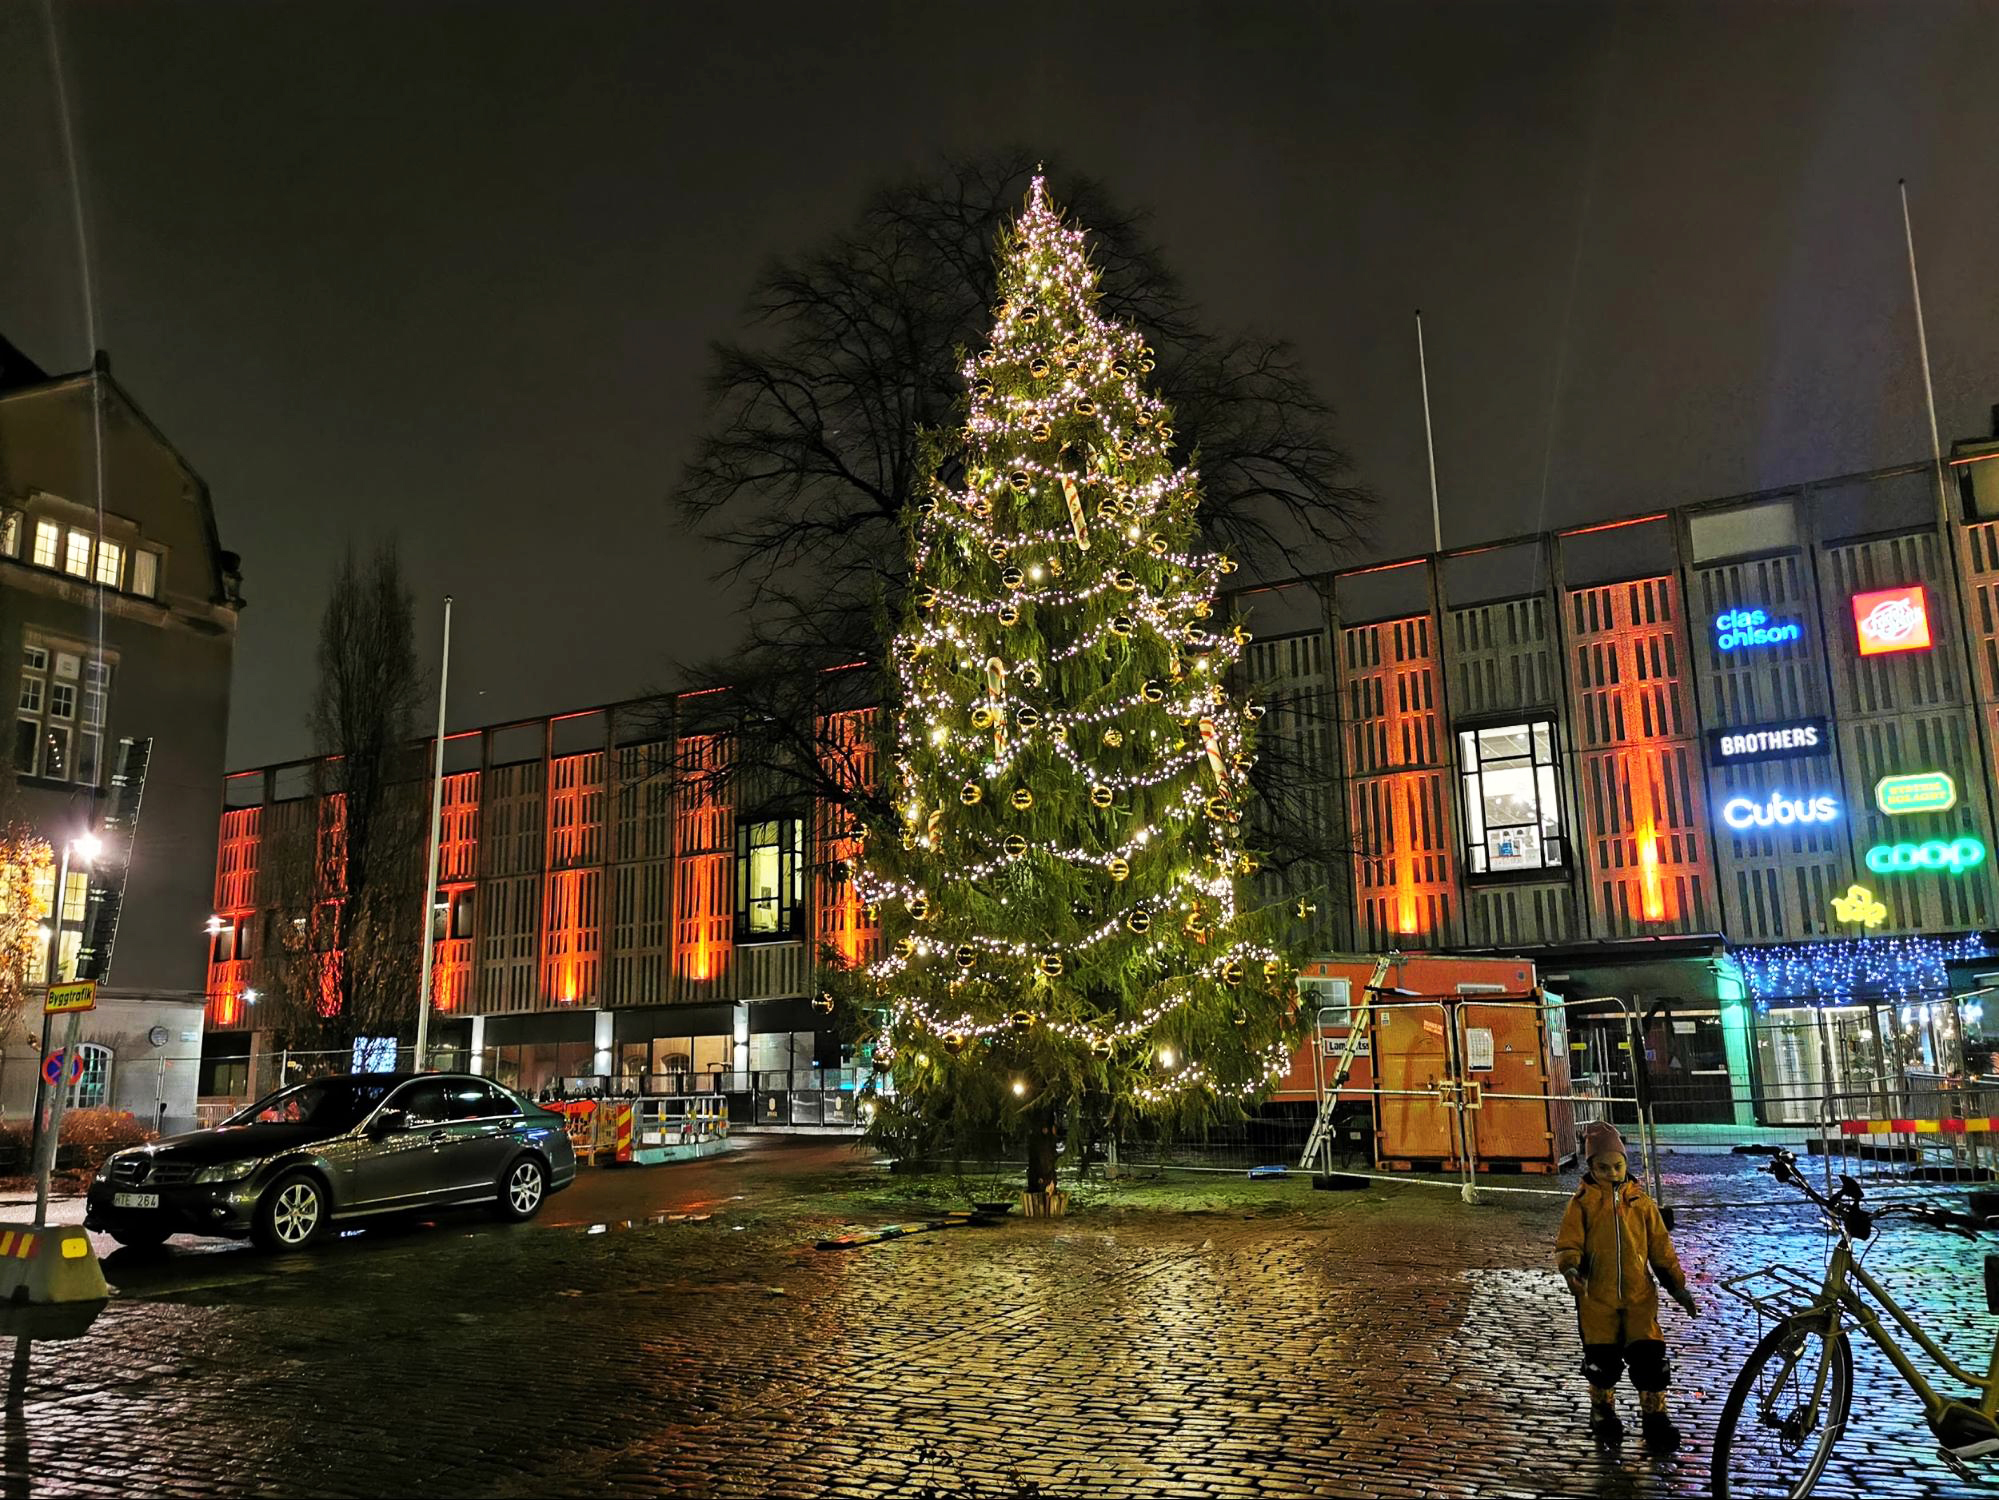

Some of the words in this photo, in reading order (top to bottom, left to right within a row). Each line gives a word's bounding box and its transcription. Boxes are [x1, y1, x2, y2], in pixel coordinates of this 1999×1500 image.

[1716, 609, 1766, 631] clas
[1718, 624, 1798, 650] ohlson
[1720, 726, 1819, 756] BROTHERS
[1723, 792, 1838, 829] Cubus
[1865, 838, 1985, 874] coop
[48, 988, 93, 1007] Byggtrafik
[137, 1195, 156, 1207] 264
